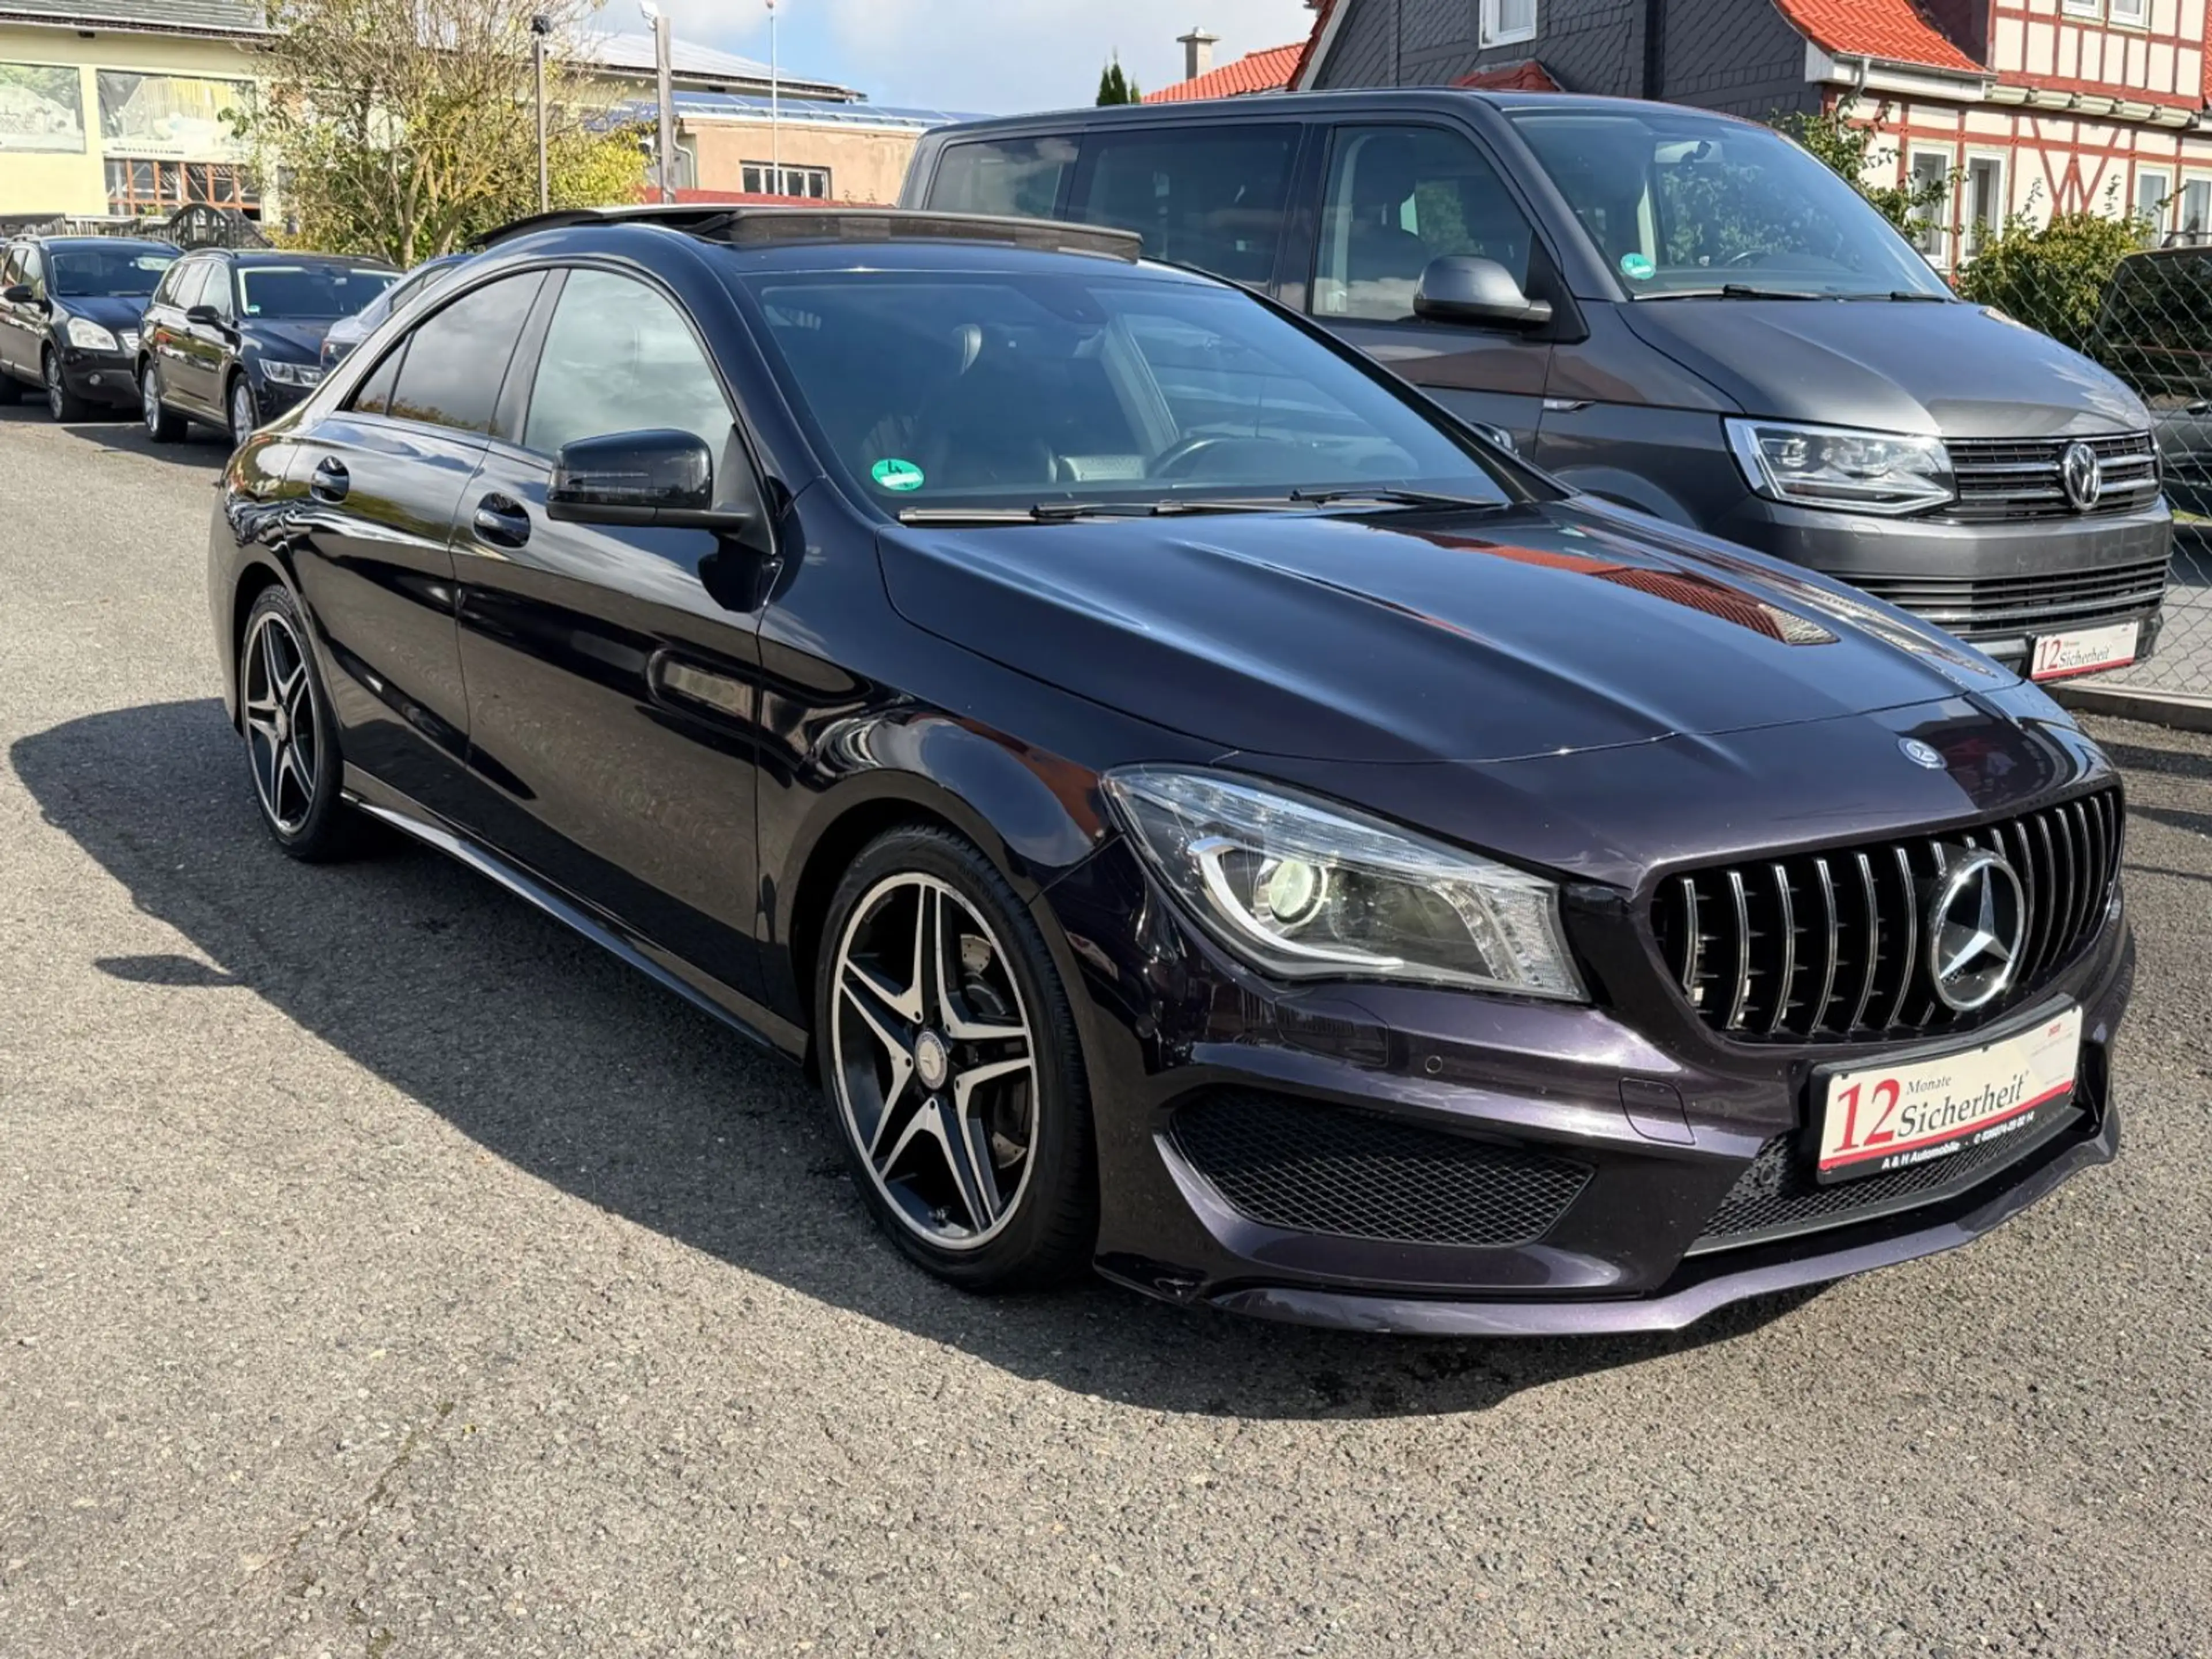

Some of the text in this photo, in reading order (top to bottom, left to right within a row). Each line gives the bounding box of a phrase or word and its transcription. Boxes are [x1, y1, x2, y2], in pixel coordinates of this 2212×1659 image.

[2037, 639, 2061, 672] 12
[1906, 1075, 1952, 1095] Monate
[1833, 1077, 1900, 1154] 12
